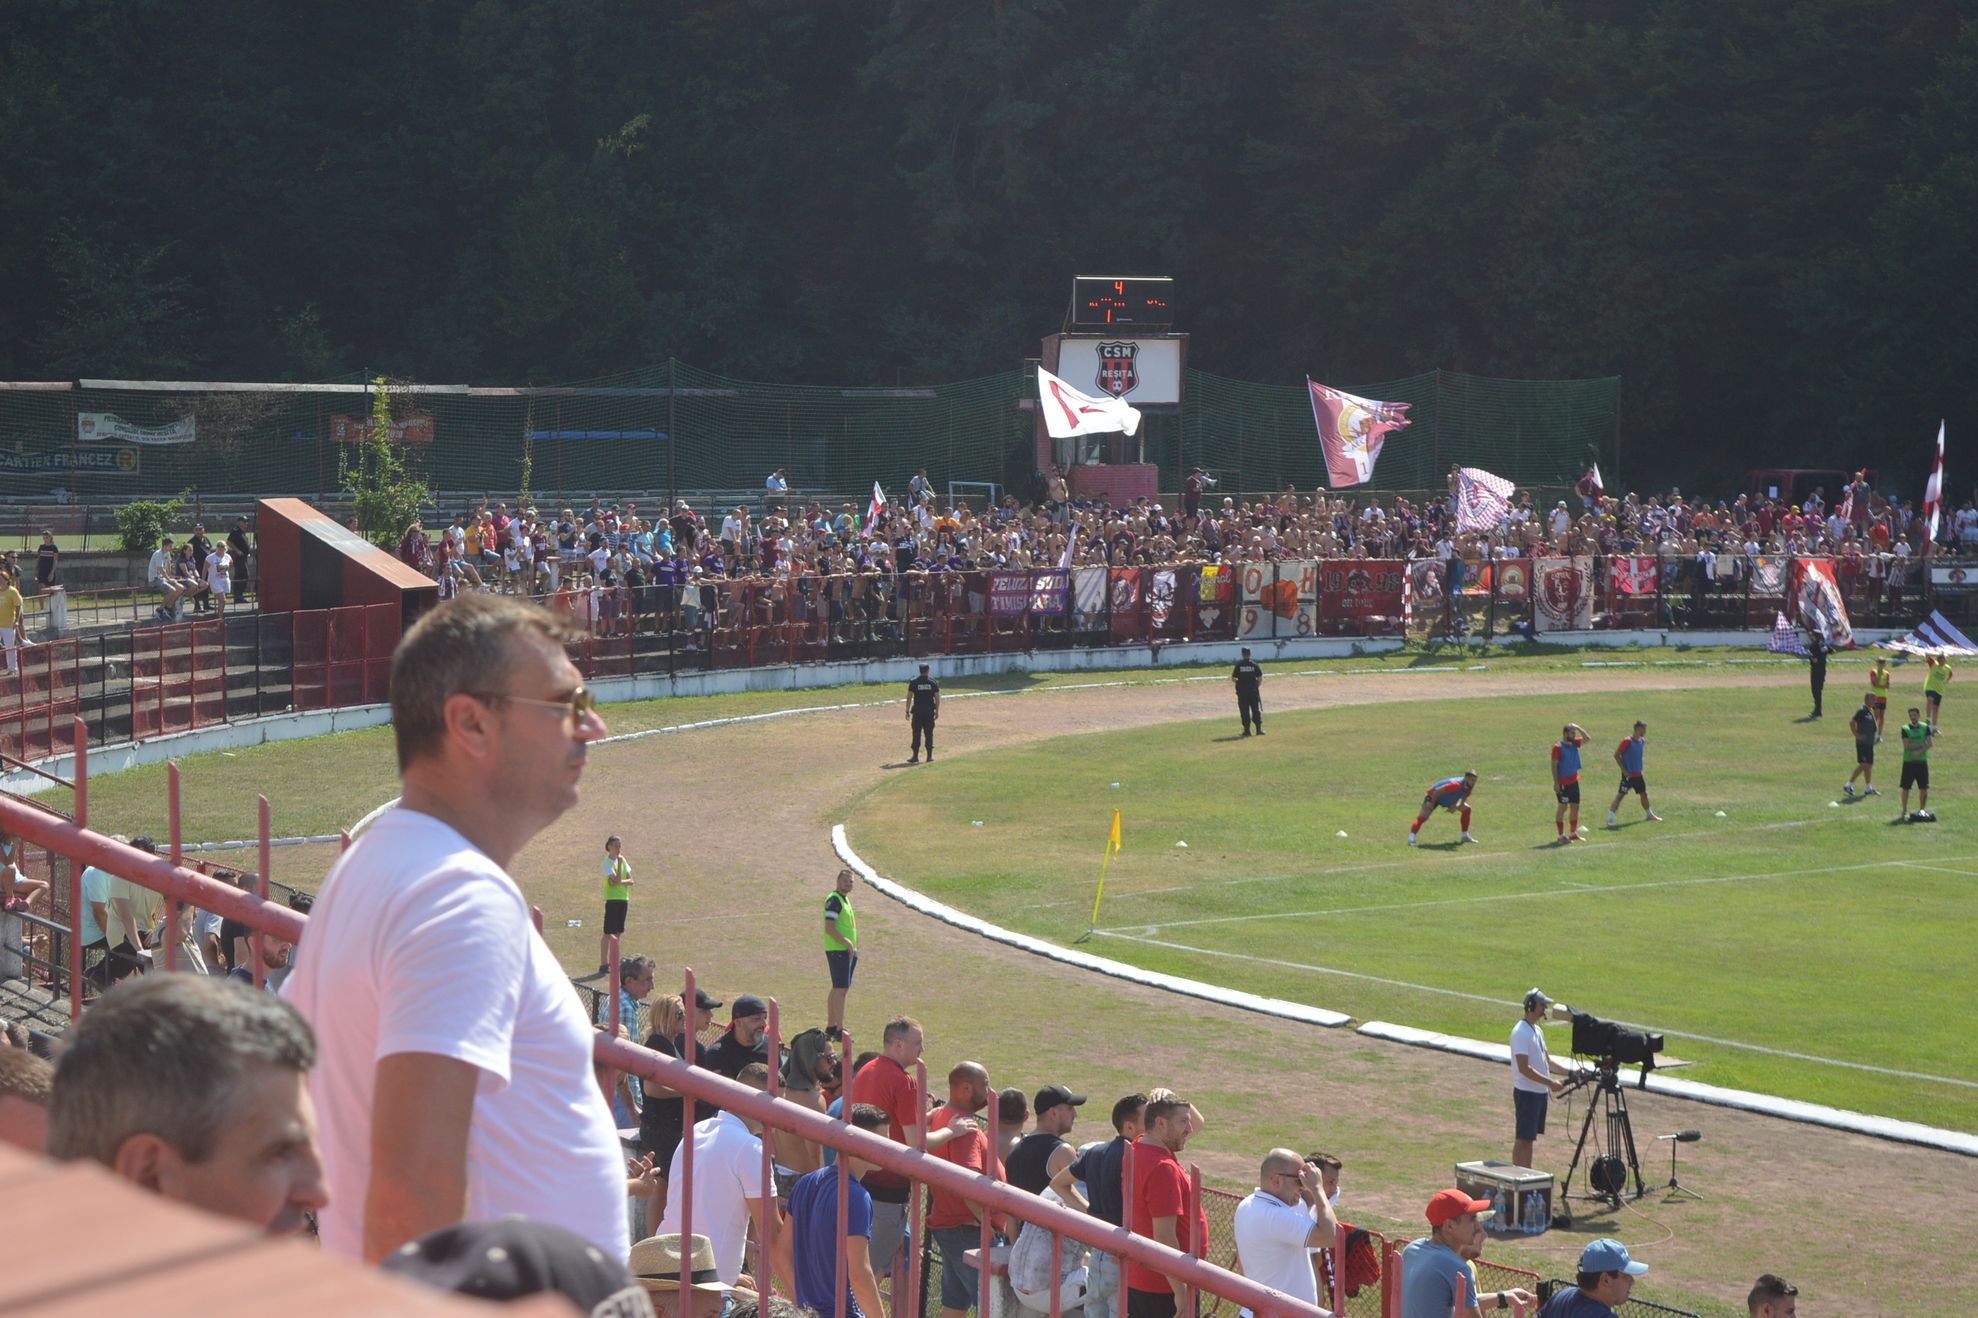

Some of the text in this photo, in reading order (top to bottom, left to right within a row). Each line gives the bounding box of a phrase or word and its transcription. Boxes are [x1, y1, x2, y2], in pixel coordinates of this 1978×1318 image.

[1104, 347, 1131, 358] CSM
[54, 453, 113, 467] FRANCEZ
[1035, 575, 1064, 590] SUD
[1300, 567, 1316, 593] H
[1244, 608, 1311, 635] 9 8
